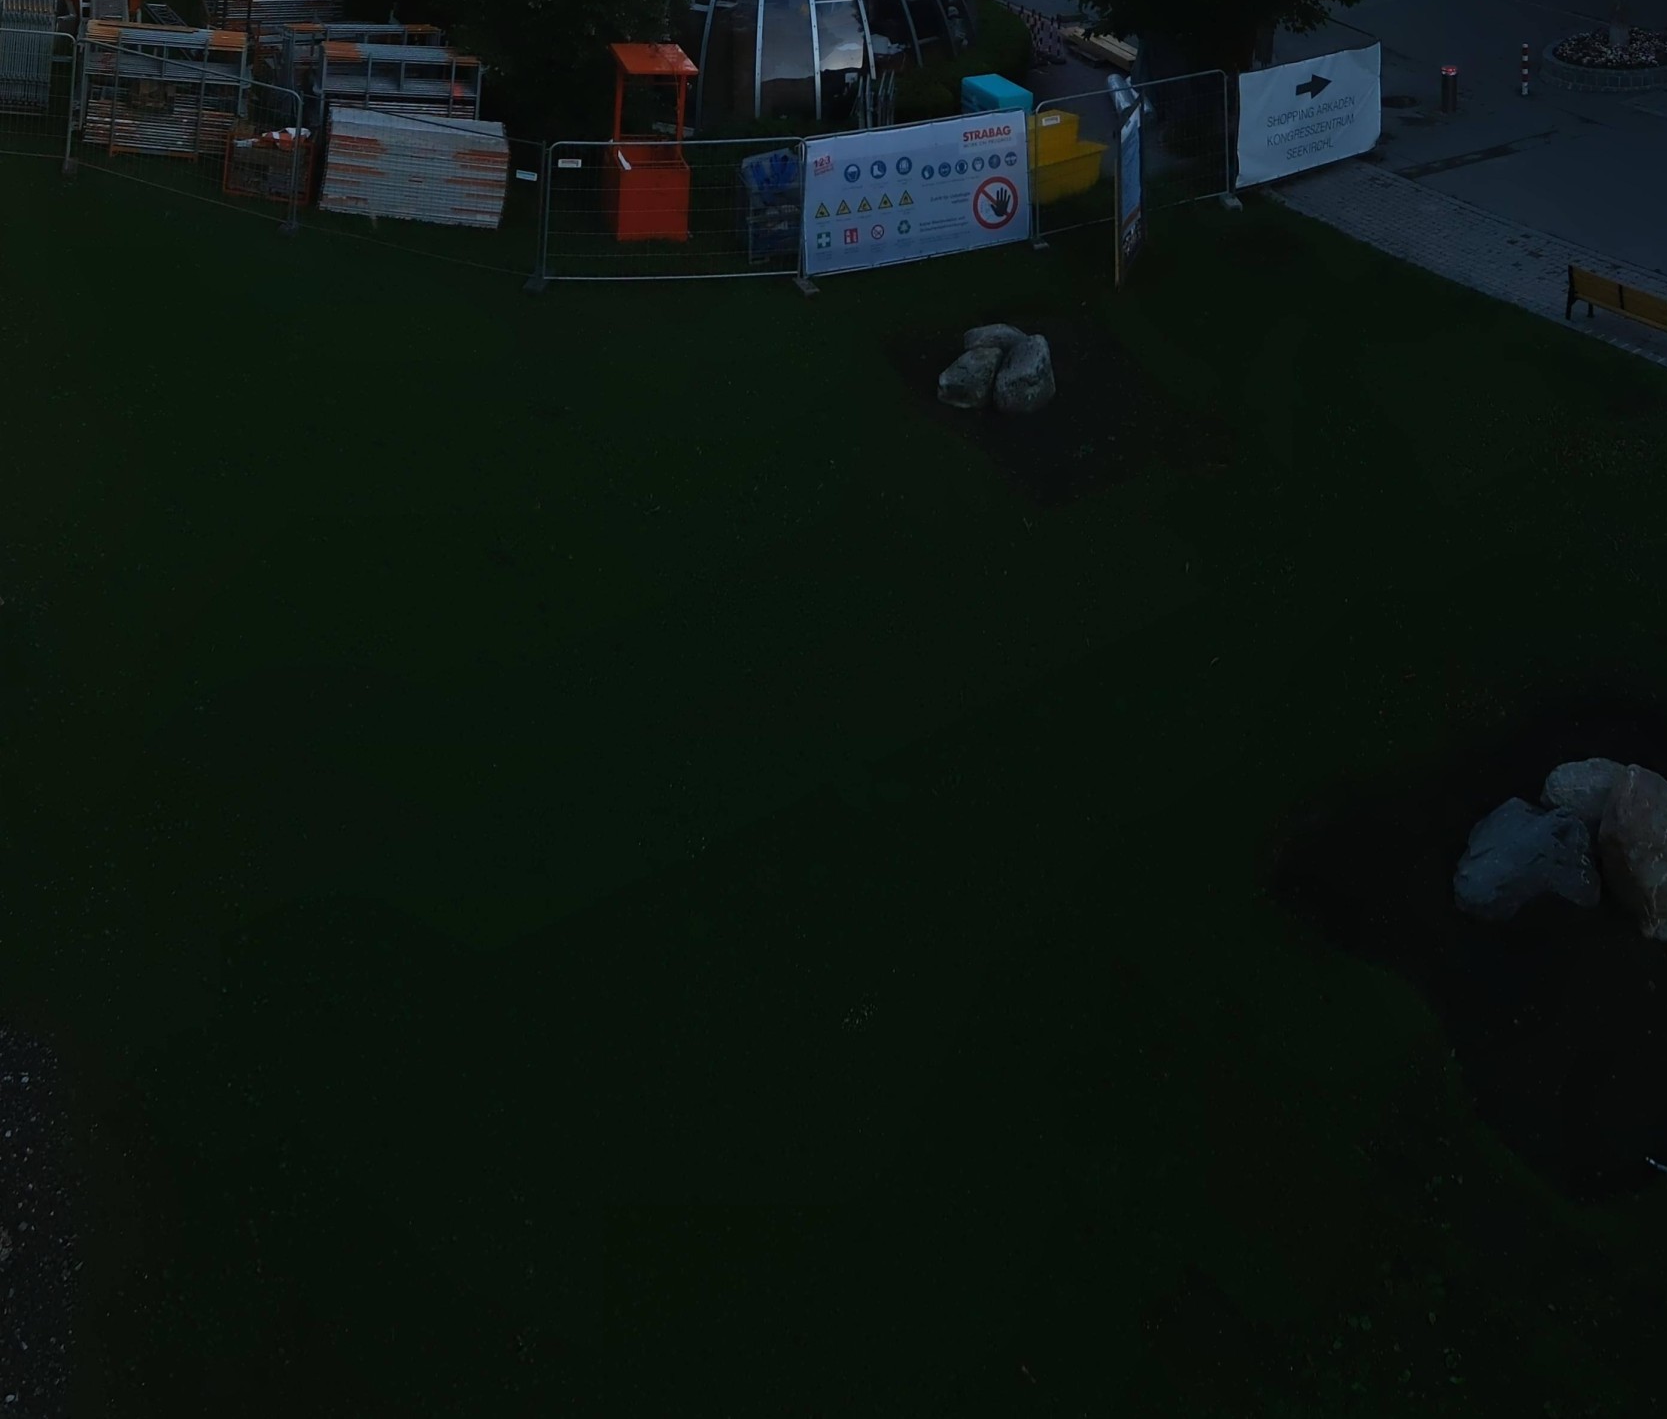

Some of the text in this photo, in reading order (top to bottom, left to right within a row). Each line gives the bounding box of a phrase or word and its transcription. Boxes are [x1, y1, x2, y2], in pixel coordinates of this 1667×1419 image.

[1266, 96, 1356, 128] SHOPPING ARKADEN
[963, 125, 1012, 142] STRABAG
[1266, 113, 1355, 147] KONGRESSZENTRUM
[1286, 136, 1334, 160] SEEKIRCHL
